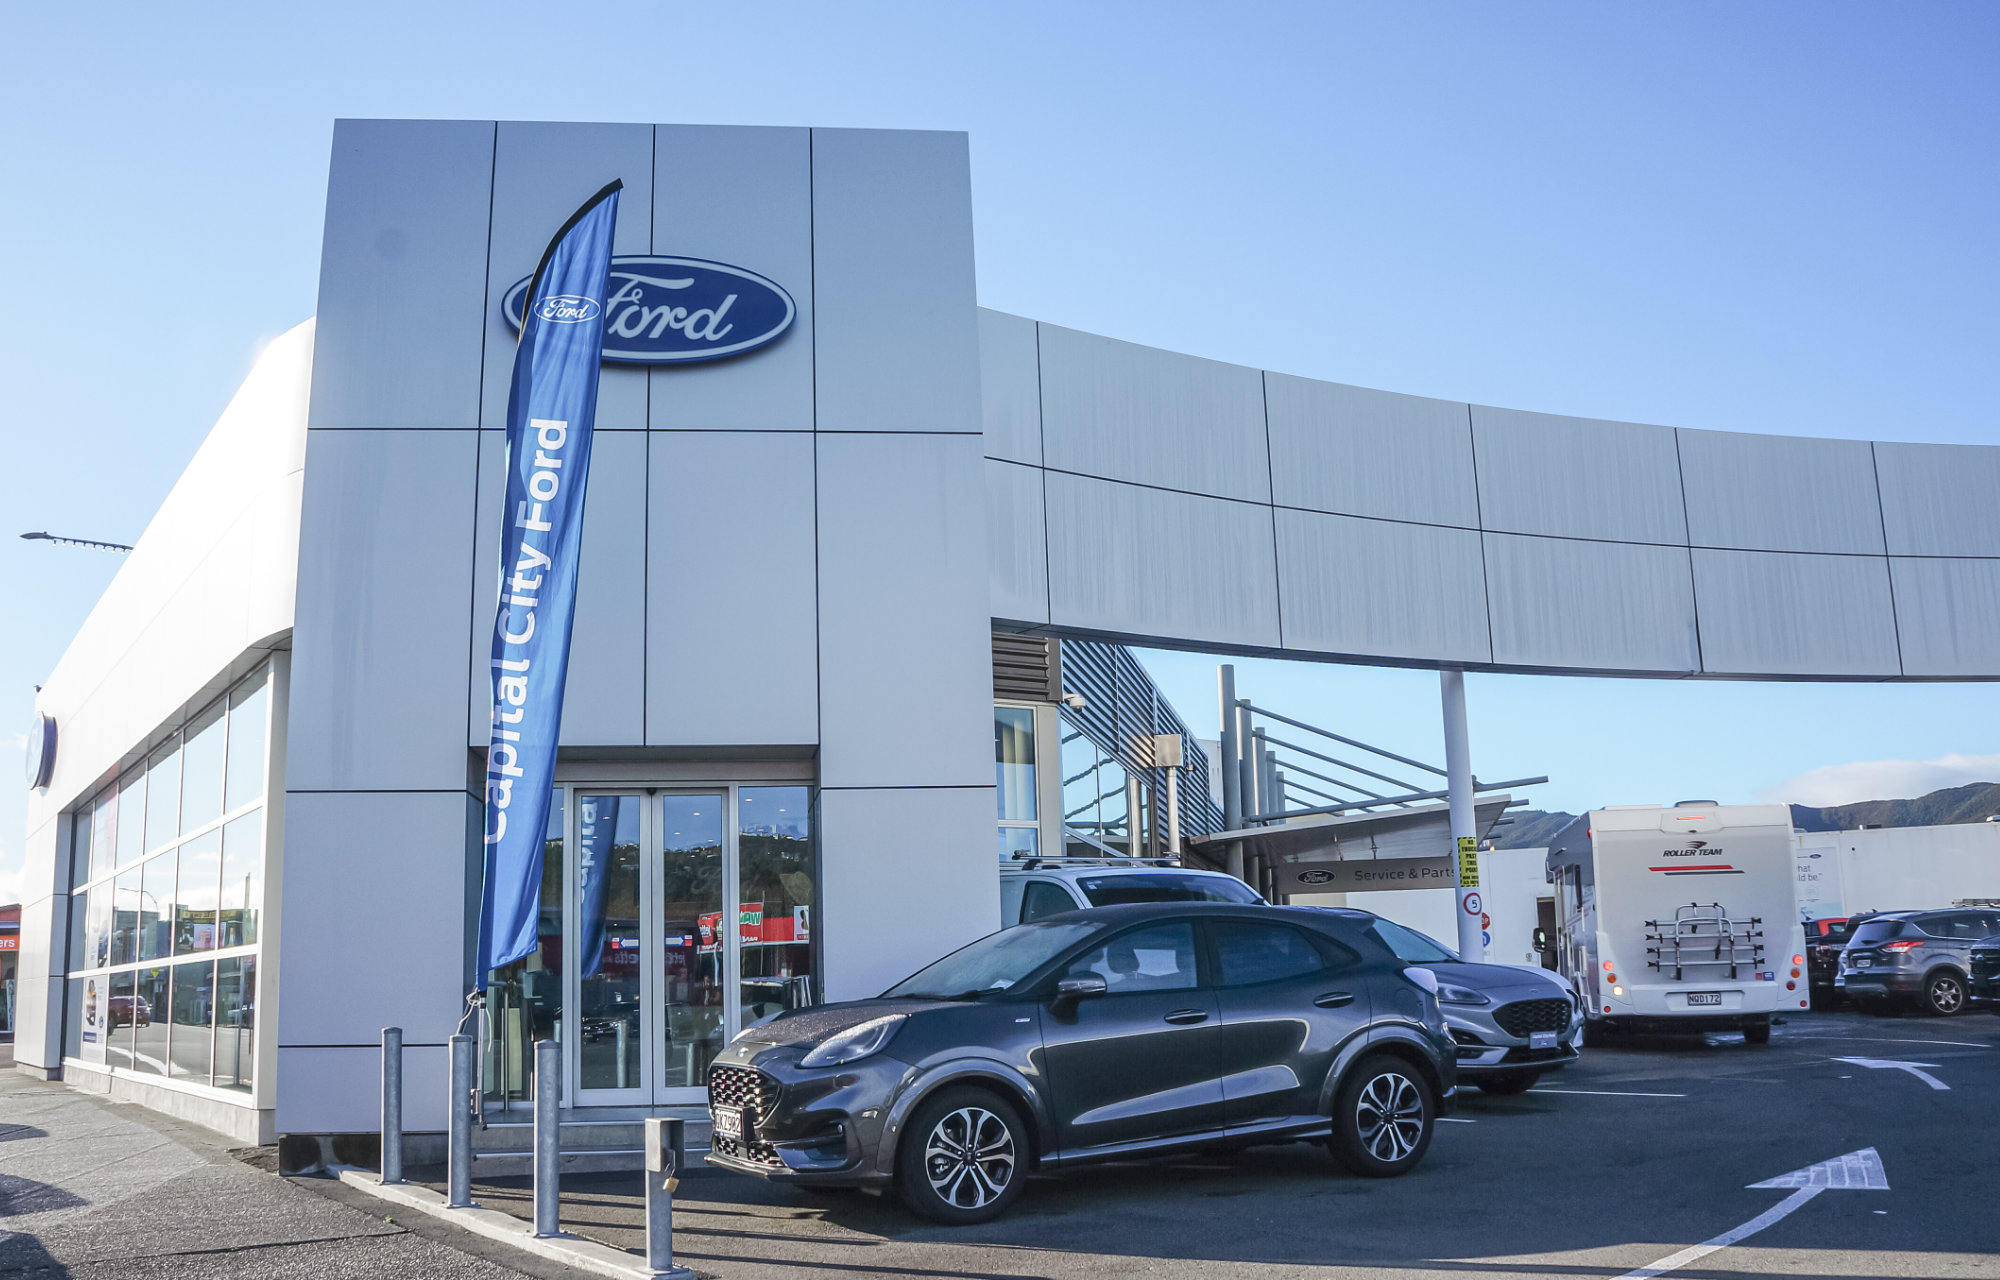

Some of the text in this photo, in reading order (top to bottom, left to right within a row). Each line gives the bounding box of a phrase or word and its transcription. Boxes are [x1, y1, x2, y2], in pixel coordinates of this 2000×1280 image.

[543, 299, 589, 318] Ford
[484, 418, 568, 844] Capital City Ford
[1699, 848, 1723, 856] TEAM
[1304, 872, 1328, 882] Ford
[1354, 870, 1405, 881] Service
[1408, 868, 1419, 879] &
[1471, 900, 1478, 908] 5
[1688, 994, 1721, 1003] NQD172
